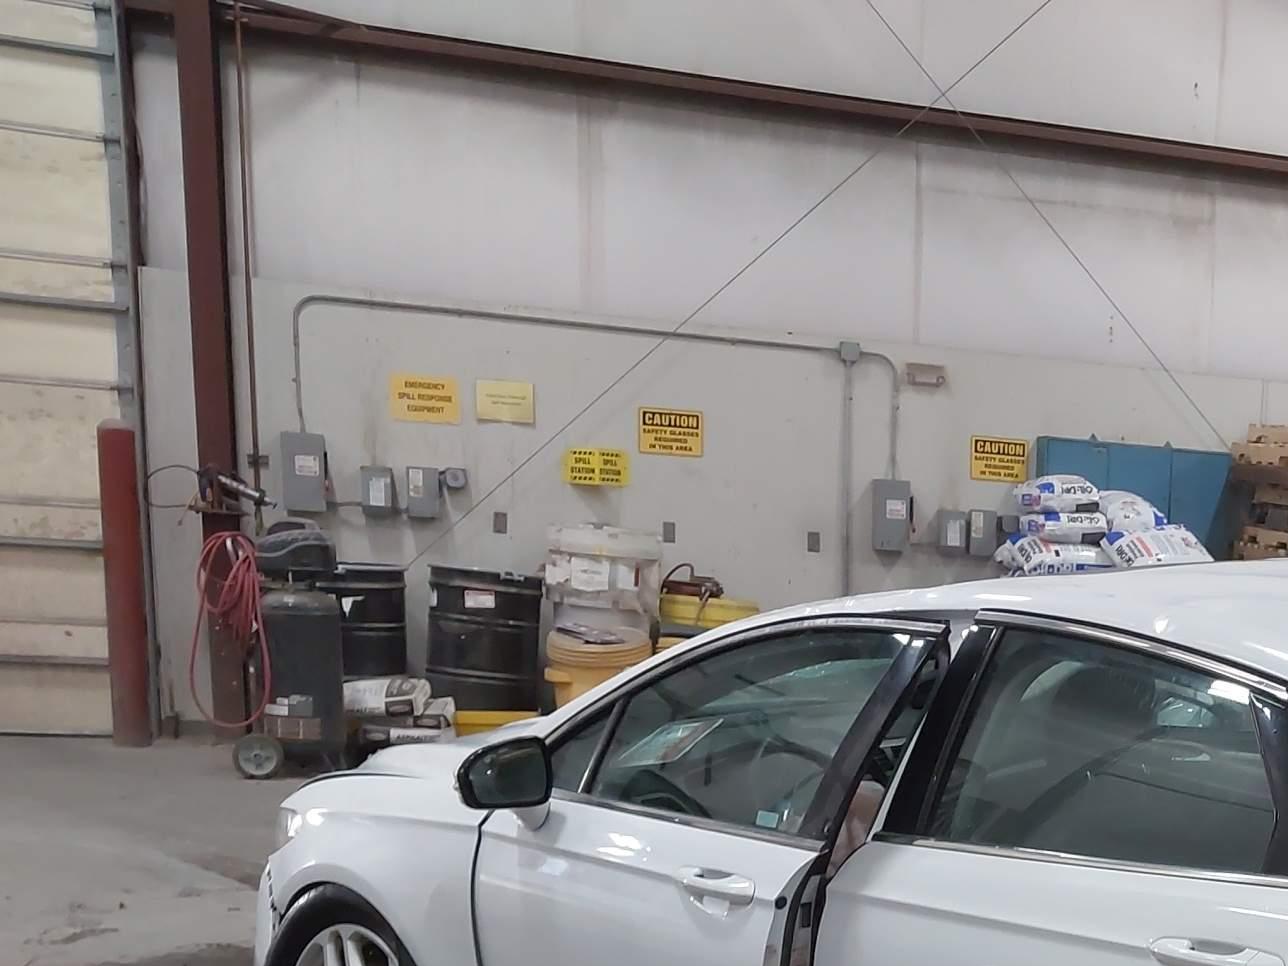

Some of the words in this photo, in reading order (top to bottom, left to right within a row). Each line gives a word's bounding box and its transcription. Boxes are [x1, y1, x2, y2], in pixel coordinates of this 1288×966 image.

[404, 381, 445, 390] EMERGENCY
[398, 392, 416, 400] SPILL
[417, 393, 452, 403] RESPONSE
[407, 404, 444, 414] EQUIPMENT
[644, 413, 698, 428] CAUTION
[643, 427, 668, 436] SAFETY
[669, 429, 699, 438] GLASSES
[654, 436, 688, 444] REQUIRED
[976, 441, 1024, 456] CAUTION
[574, 457, 591, 465] SPILL
[602, 458, 617, 467] SPILL
[998, 457, 1025, 465] GLASSES
[570, 466, 596, 475] STATION
[599, 468, 622, 476] STATION
